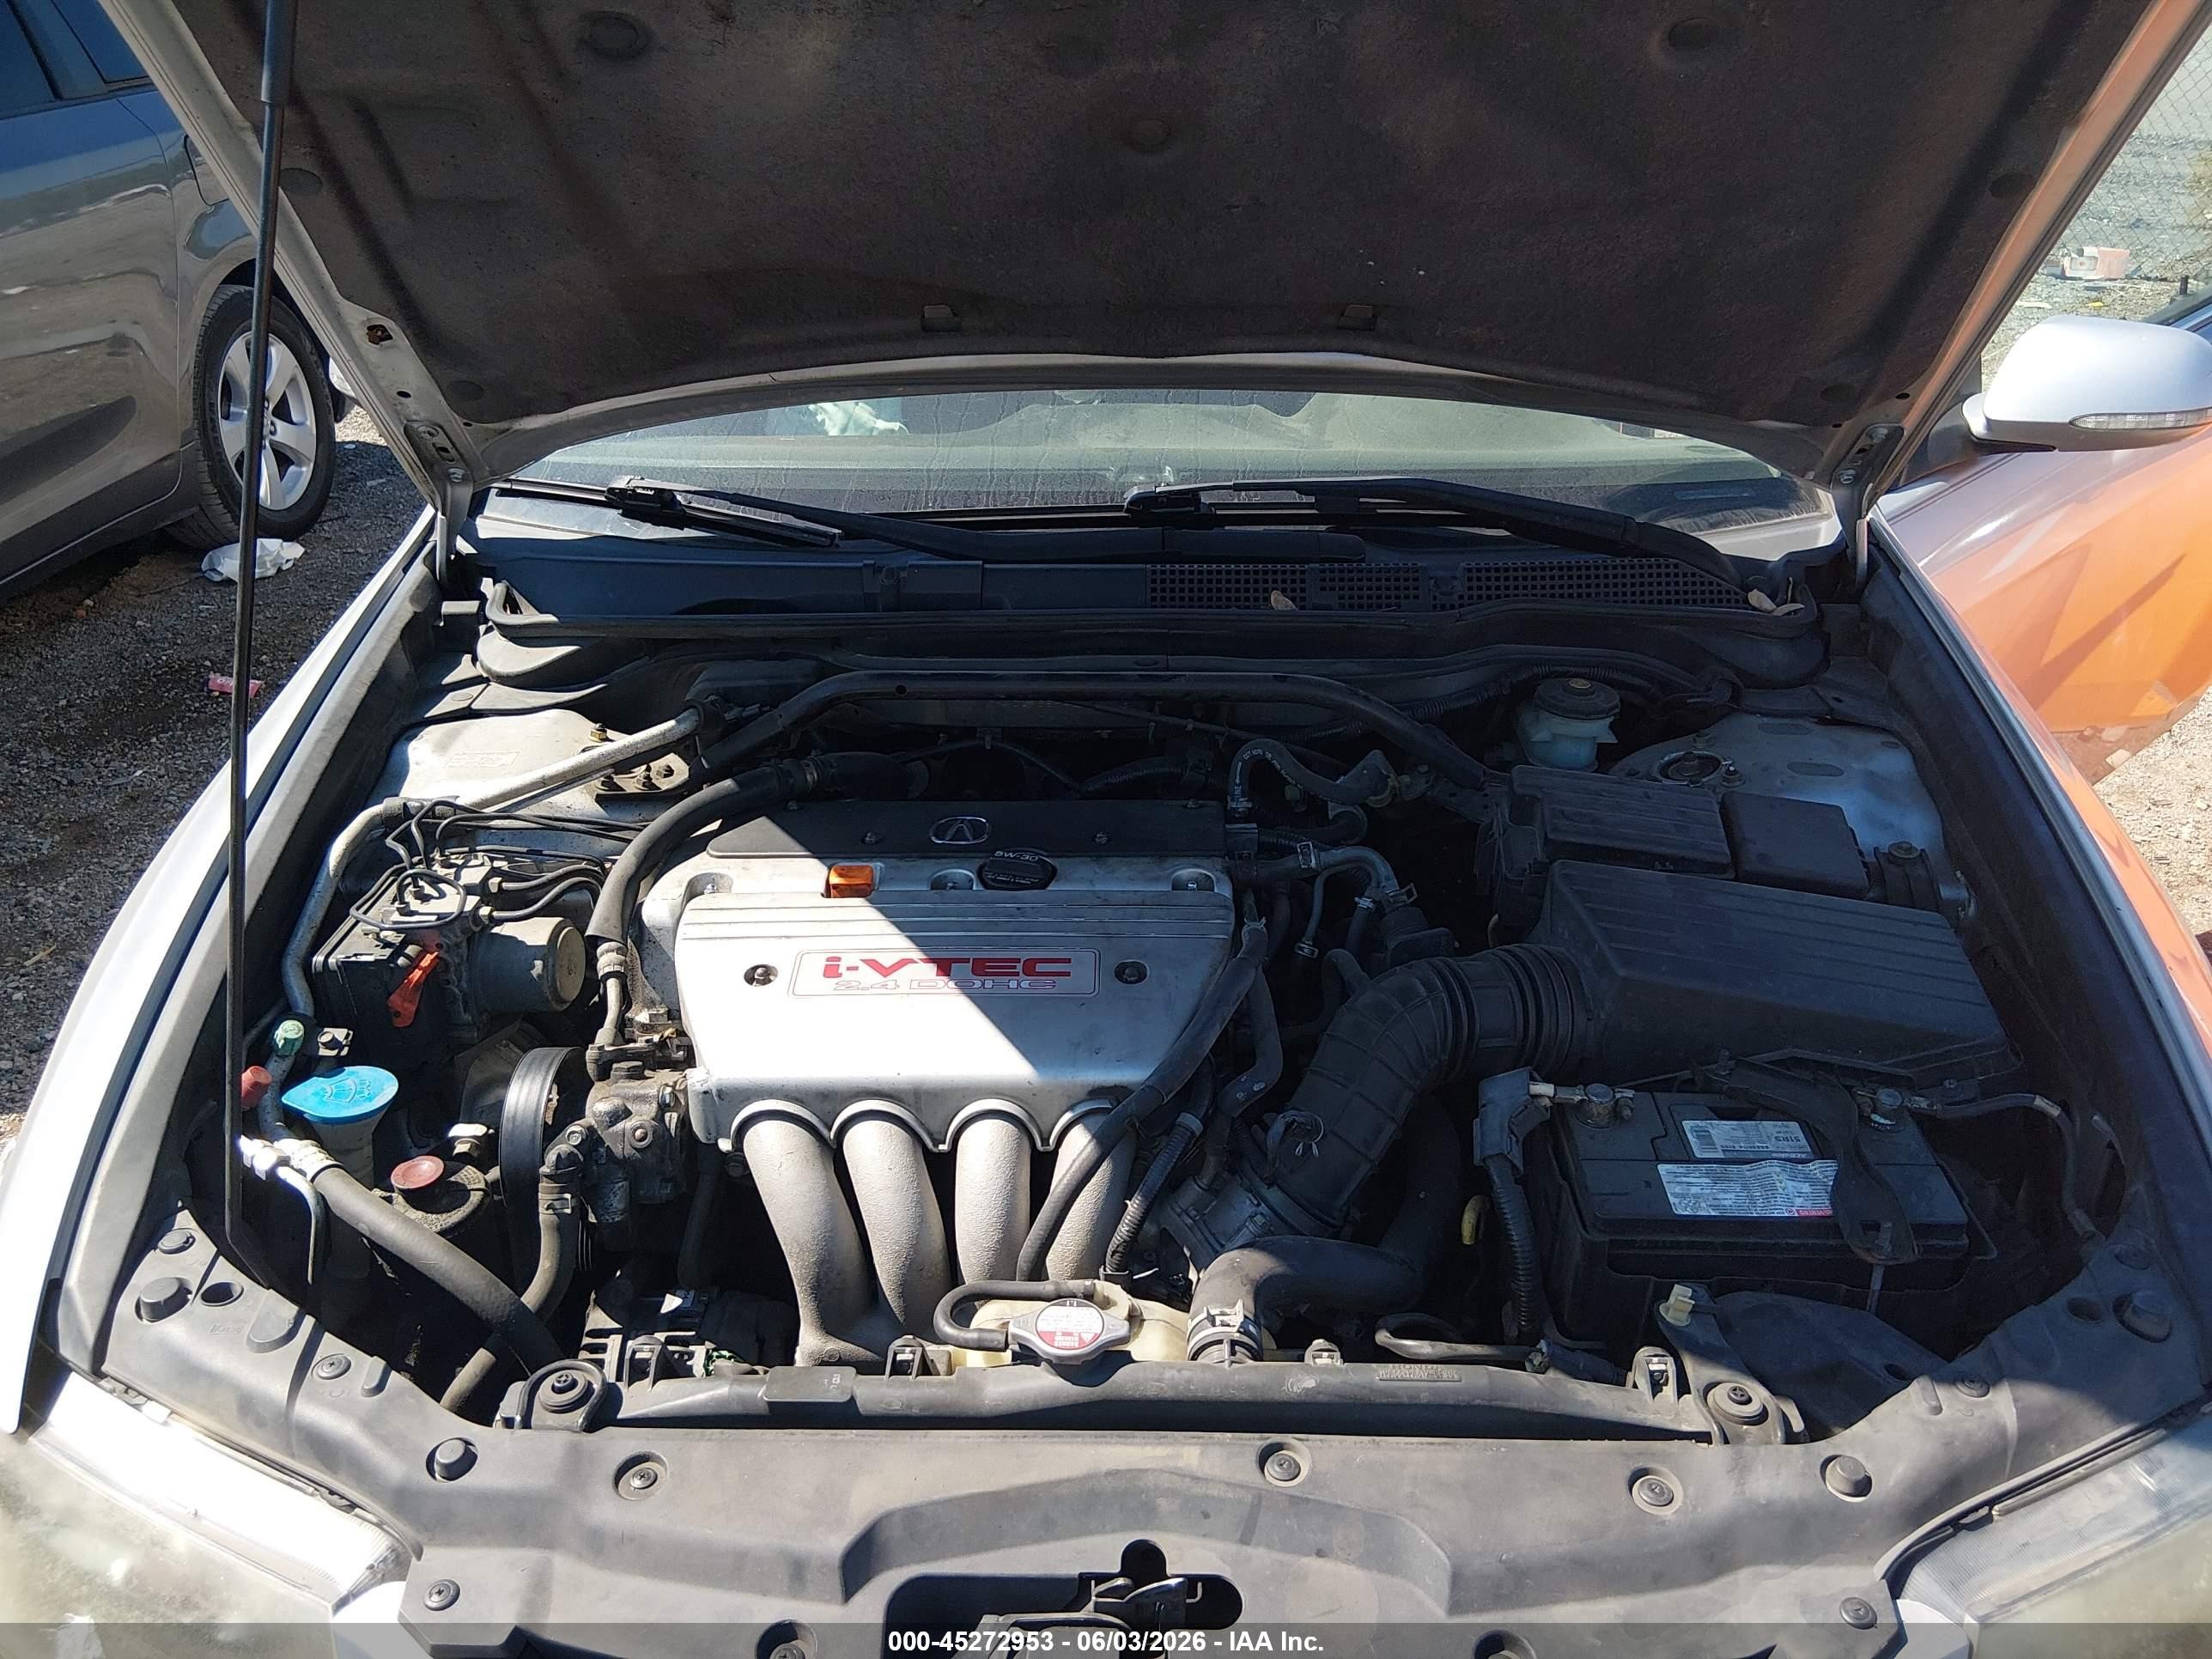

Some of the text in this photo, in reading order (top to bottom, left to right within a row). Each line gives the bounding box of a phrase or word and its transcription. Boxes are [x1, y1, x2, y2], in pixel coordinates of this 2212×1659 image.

[994, 849, 1039, 862] 5W-30
[822, 956, 1073, 978] i-VTEC
[833, 979, 1057, 991] 2.4 DOHC
